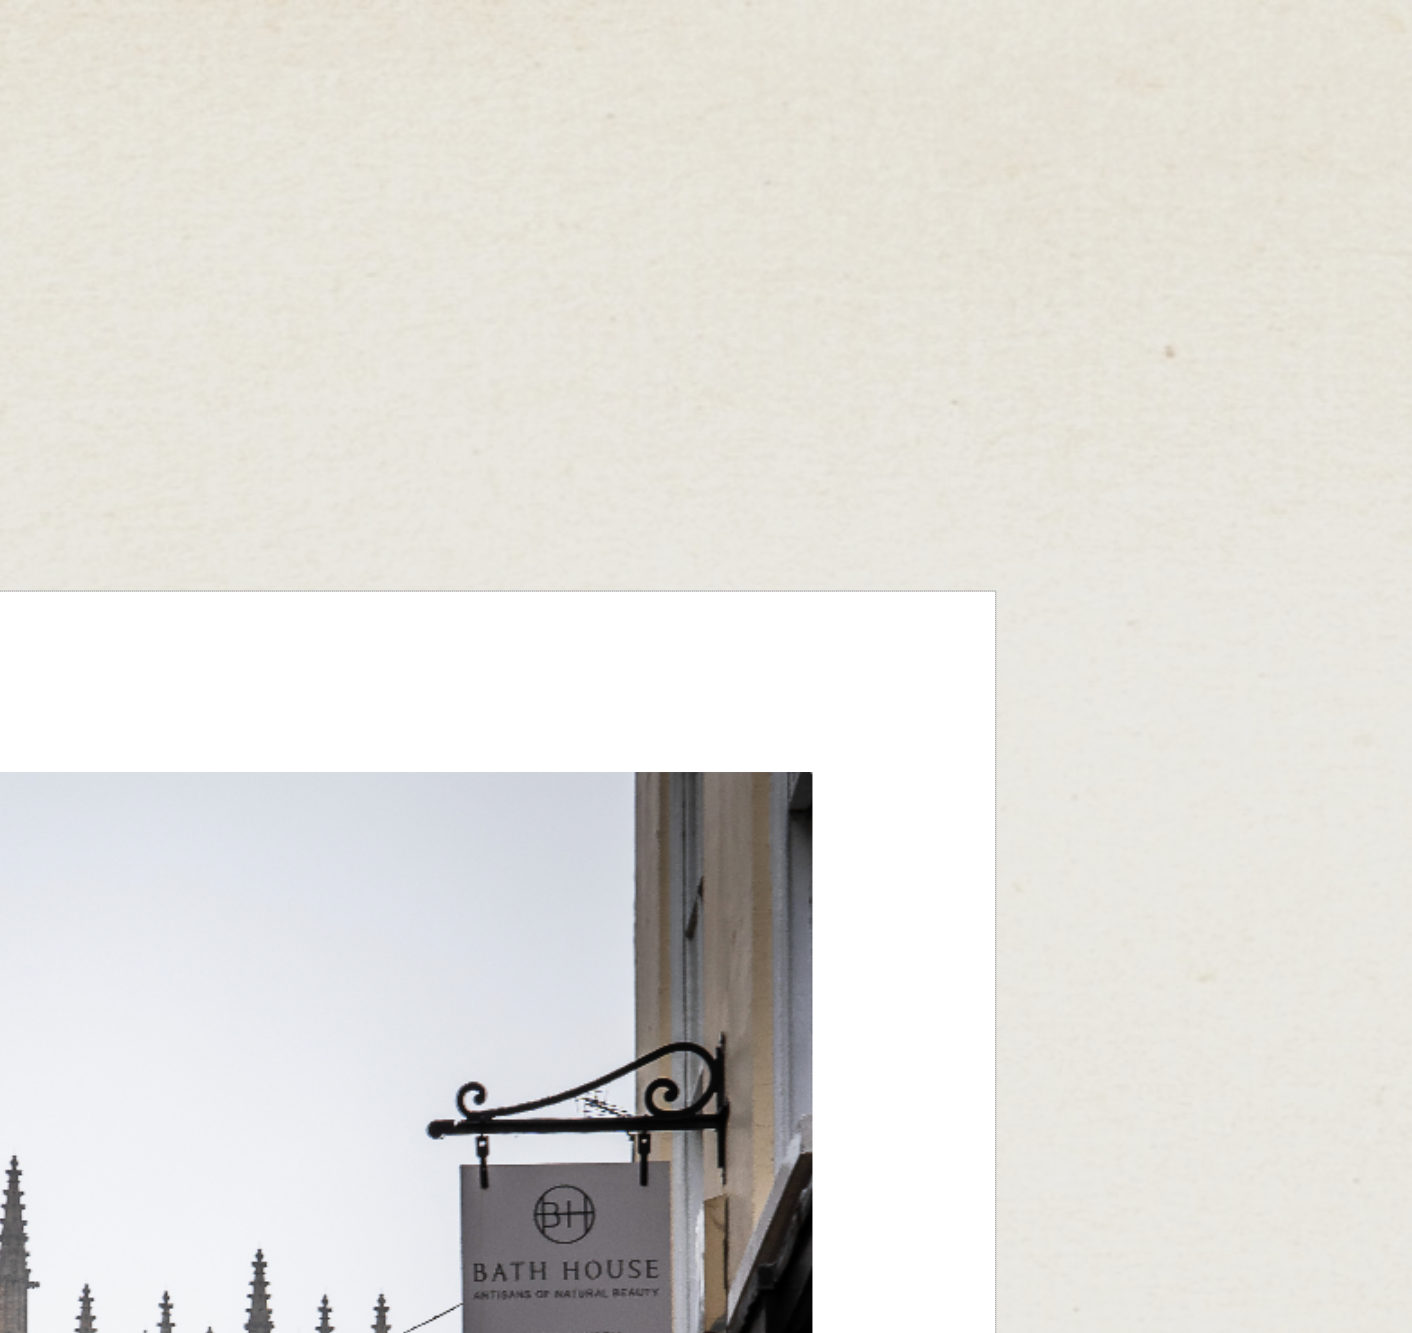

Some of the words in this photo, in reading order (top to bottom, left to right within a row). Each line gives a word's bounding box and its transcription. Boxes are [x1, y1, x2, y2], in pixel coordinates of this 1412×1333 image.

[473, 1260, 548, 1283] BATH
[562, 1259, 661, 1281] HOUSE
[473, 1289, 532, 1300] ARTISANS
[534, 1289, 551, 1299] OF
[554, 1288, 608, 1299] NATURAL
[612, 1287, 660, 1298] BEAUTY
